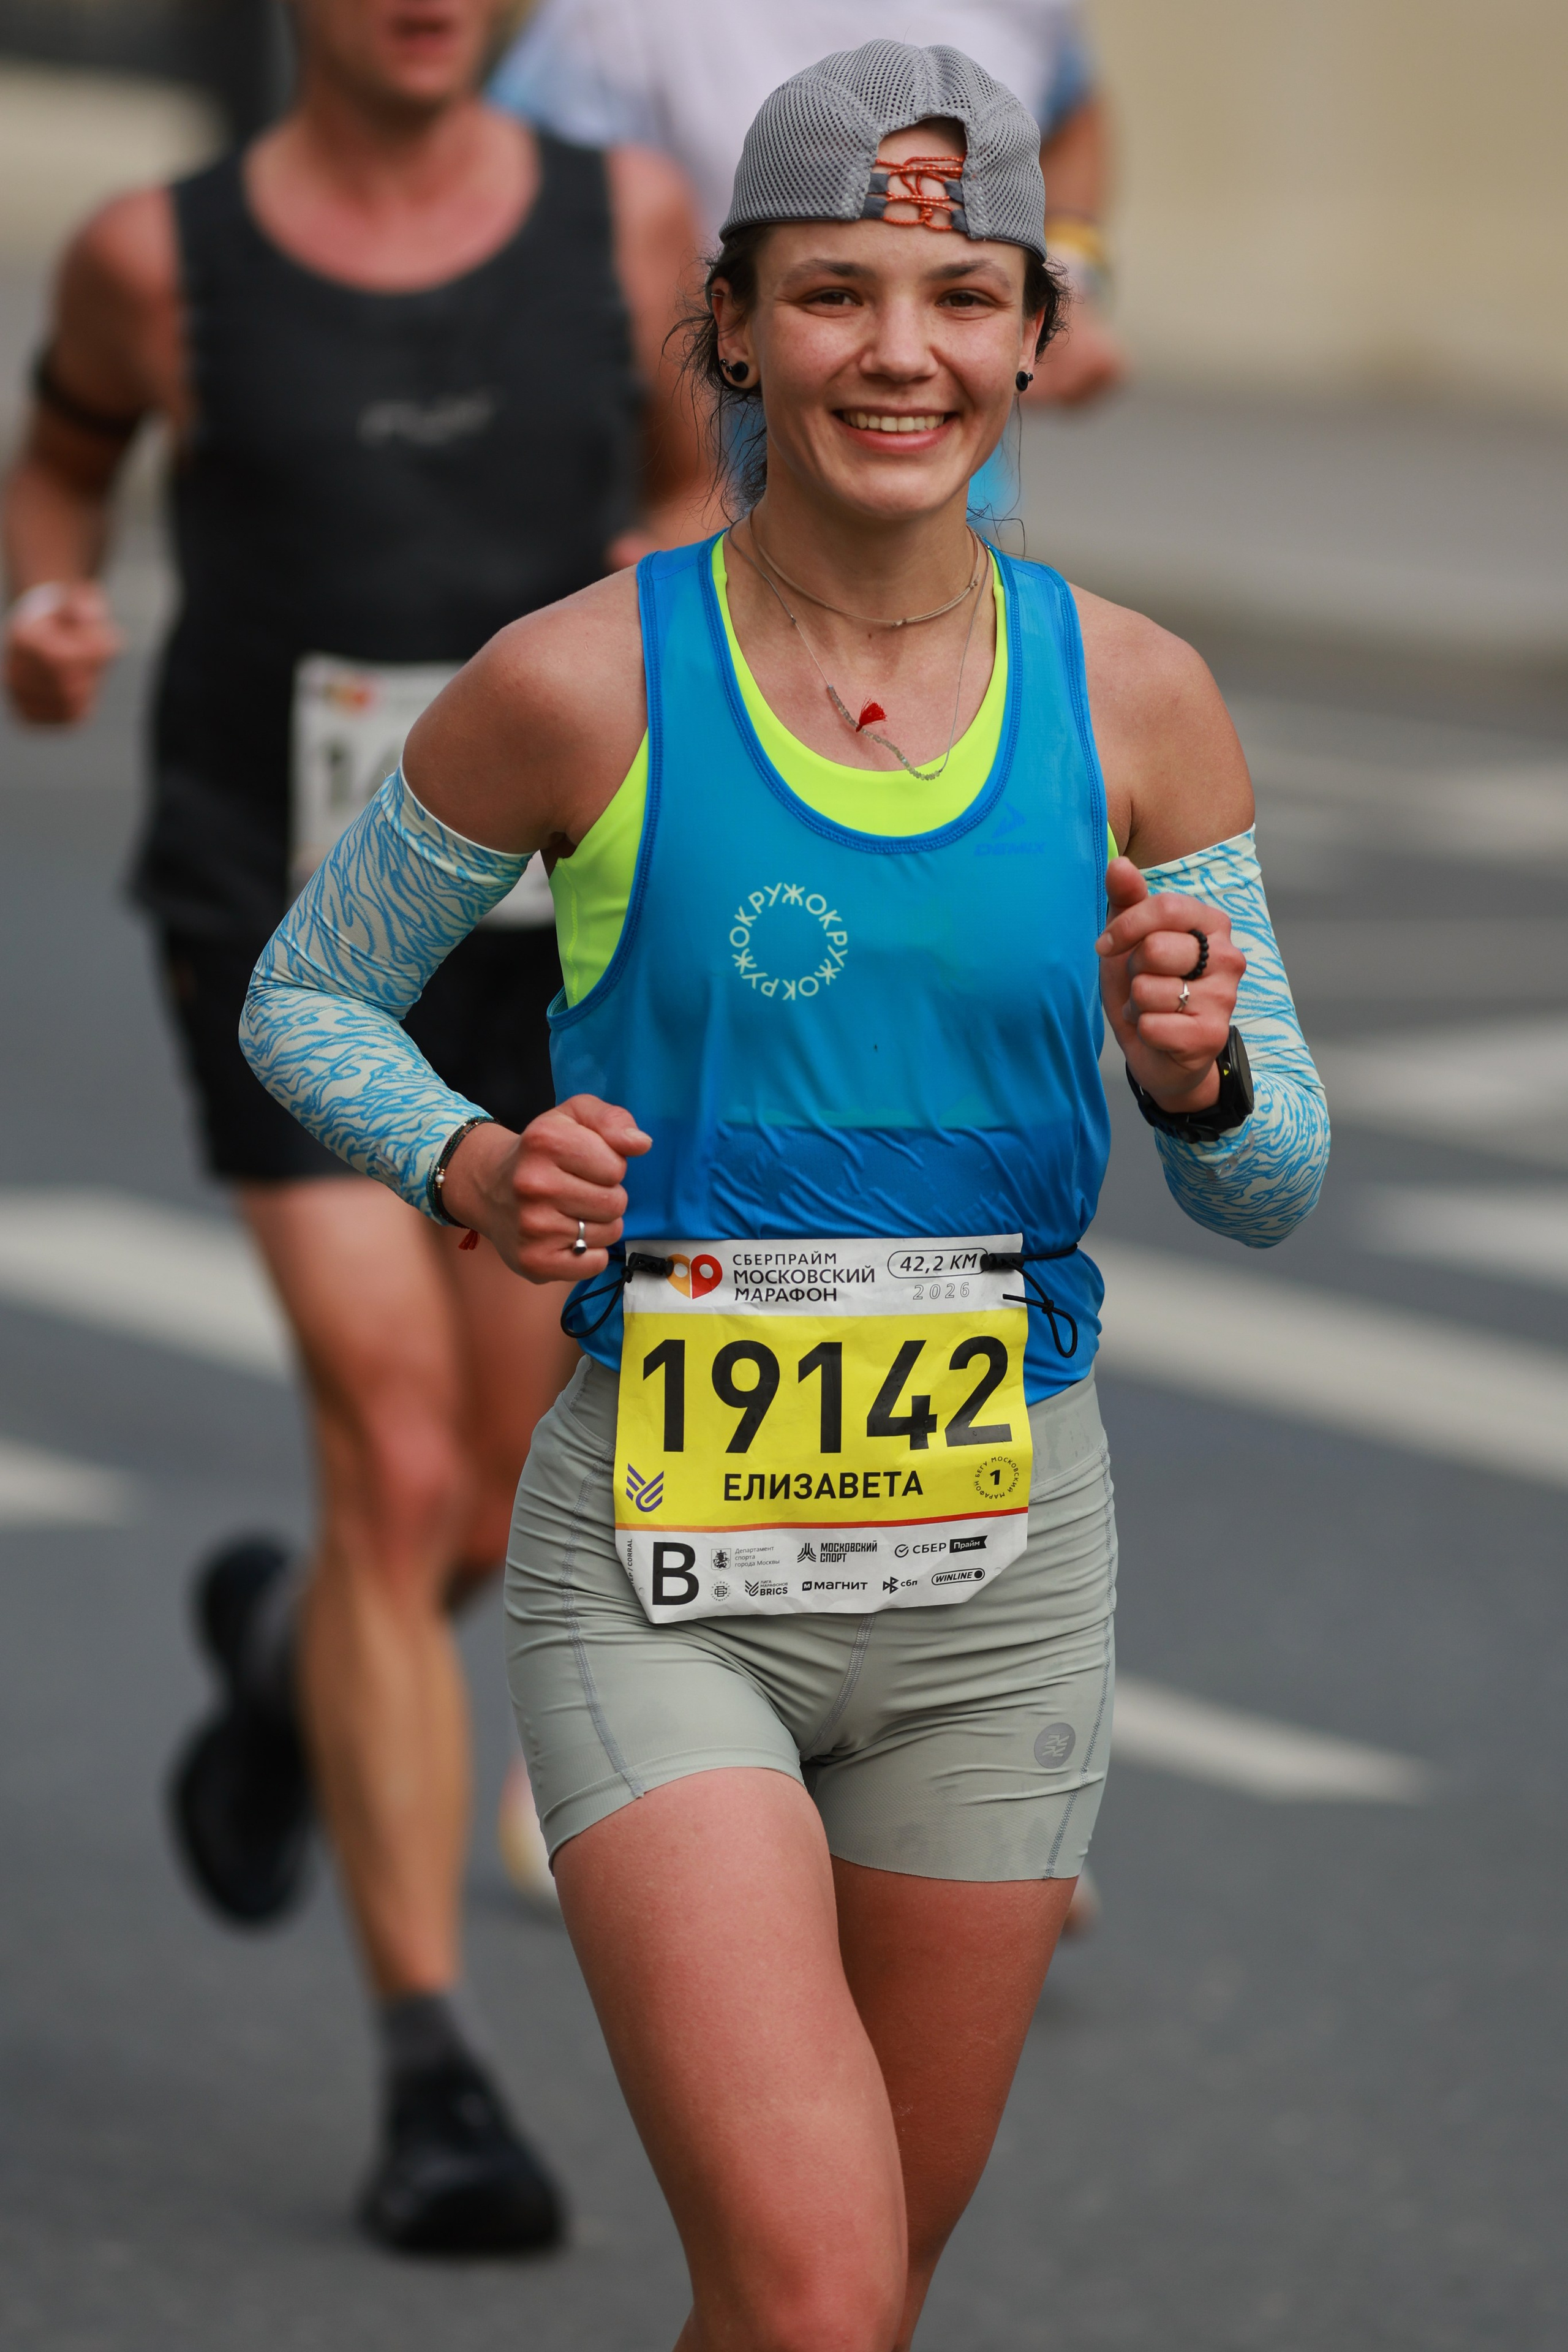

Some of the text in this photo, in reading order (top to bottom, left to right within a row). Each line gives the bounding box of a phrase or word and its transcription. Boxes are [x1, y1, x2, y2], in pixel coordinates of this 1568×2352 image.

[733, 1251, 837, 1265] СБЕРПРАЙМ
[900, 1256, 944, 1273] 42,2
[733, 1265, 875, 1284] МОСКОВСКИЙ
[734, 1287, 837, 1302] МАРАФОН
[913, 1282, 970, 1300] 2026
[643, 1335, 1013, 1454] 19142
[974, 1456, 1019, 1499] БЕГУ МОСКОВСКИЙ МАРАФОН
[990, 1469, 1000, 1485] 1
[723, 1470, 924, 1501] ЕЛИЗАВЕТА
[821, 1540, 877, 1552] МОСКОВСКИЙ
[913, 1540, 981, 1554] СБЕР Прайм
[820, 1553, 847, 1562] СПОРТ
[936, 1571, 973, 1583] WINLINE
[760, 1586, 788, 1596] BRICS
[814, 1581, 869, 1590] магнит
